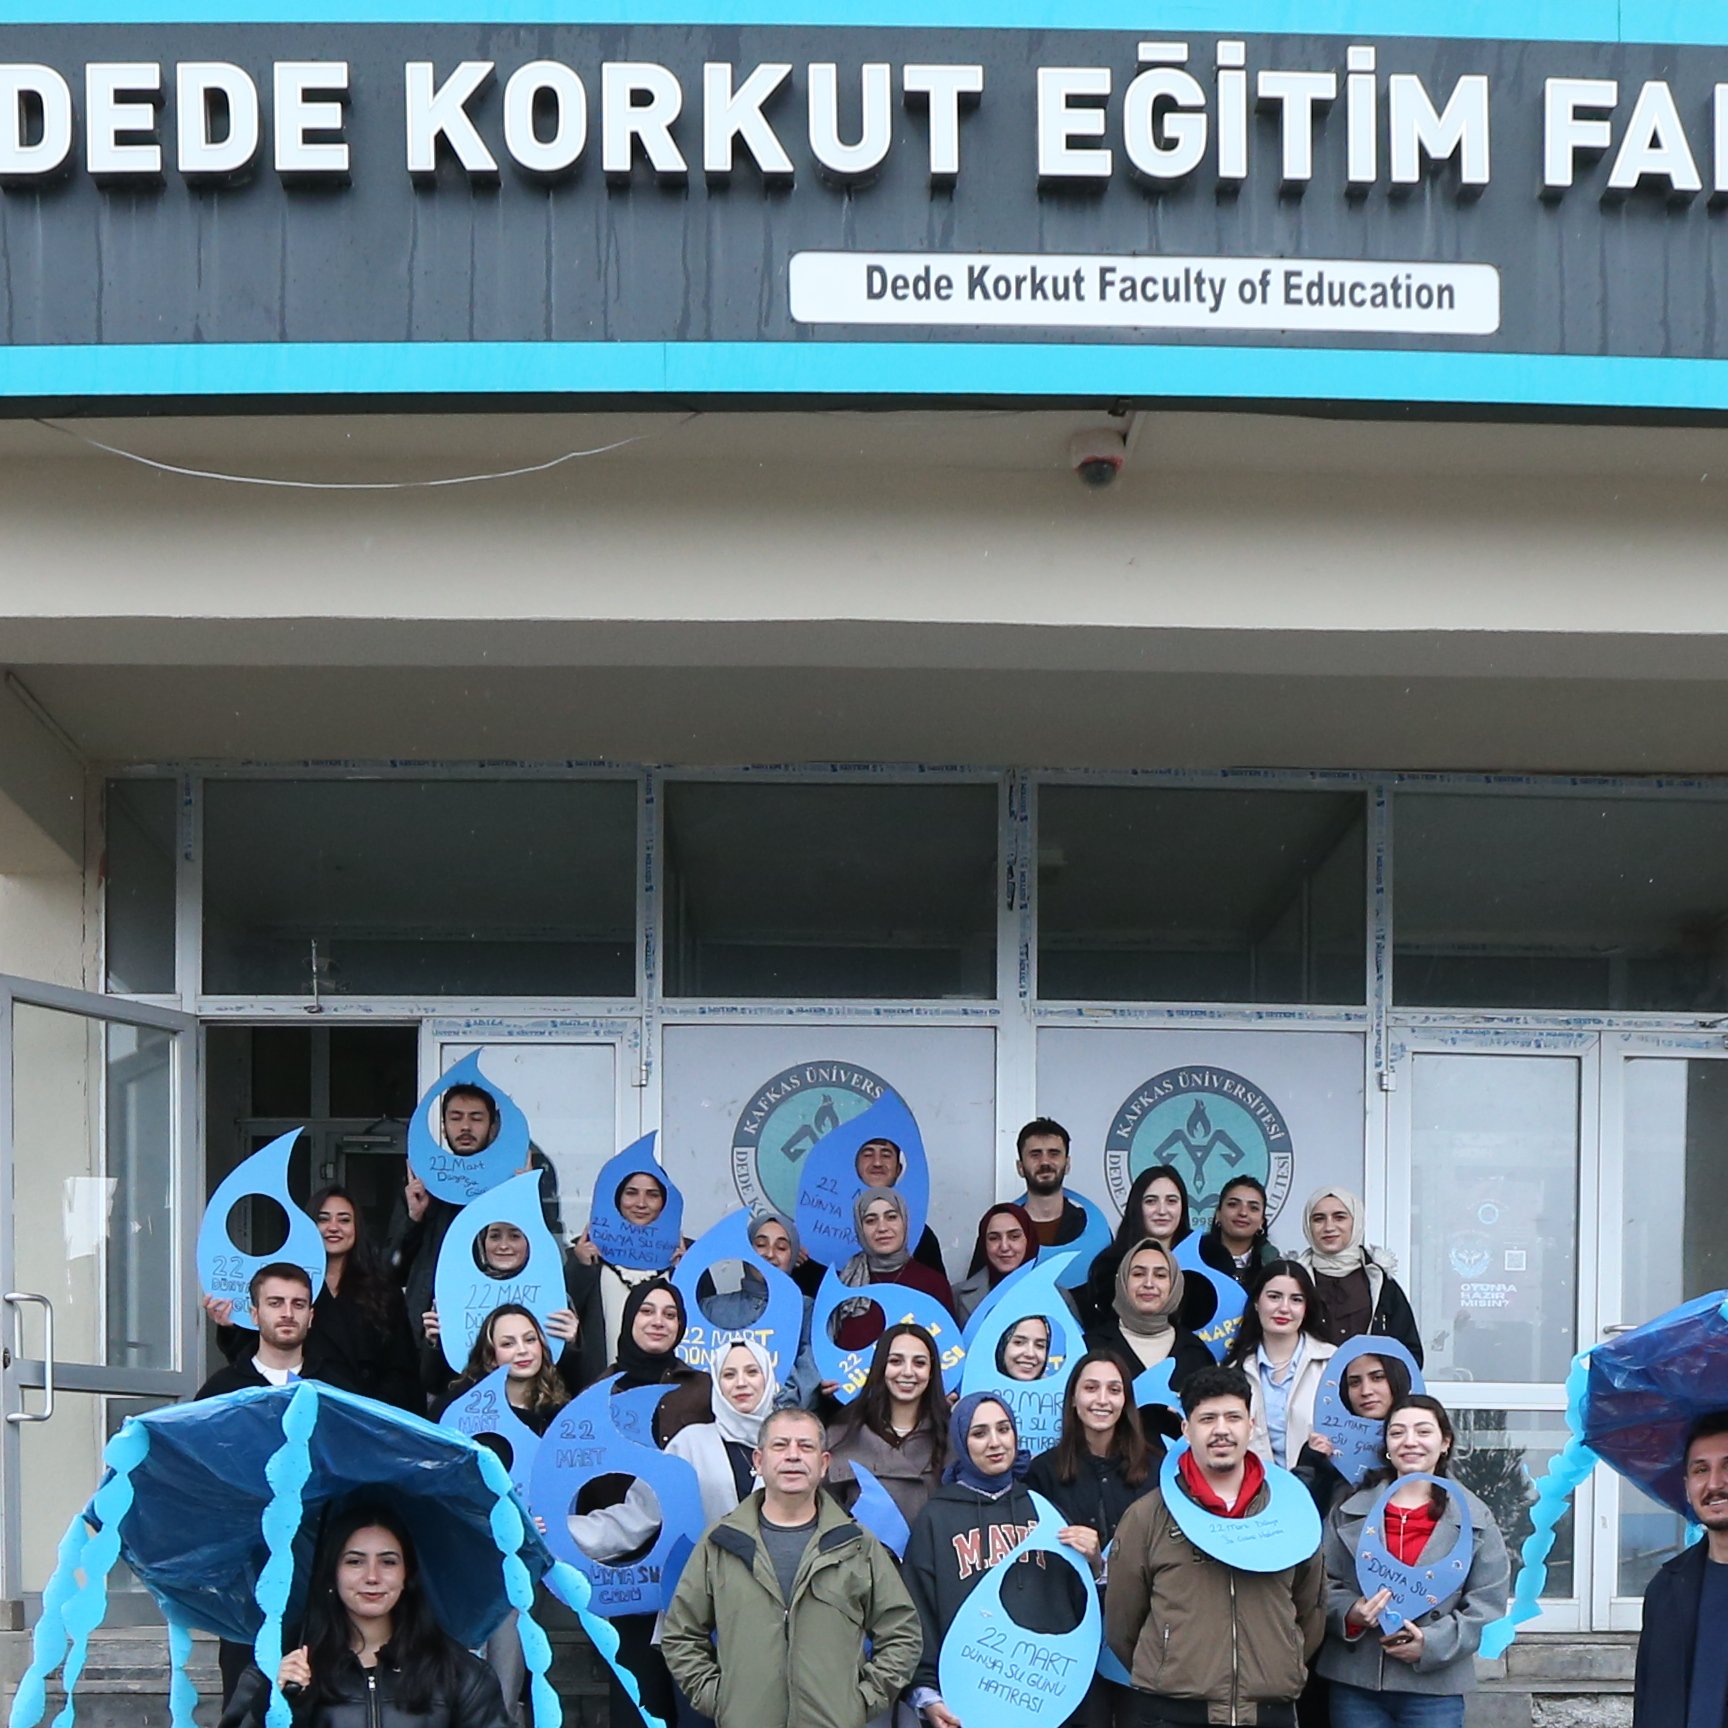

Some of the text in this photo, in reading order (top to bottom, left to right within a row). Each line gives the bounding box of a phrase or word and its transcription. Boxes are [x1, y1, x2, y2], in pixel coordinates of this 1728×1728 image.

[405, 60, 984, 174] KORKUT
[1037, 40, 1491, 184] EĞİTİM
[866, 265, 1455, 313] Dede Korkut Faculty of Education
[743, 1065, 884, 1136] KAFKAS ÜNİVERS
[1116, 1070, 1286, 1141] KAFKAS ÜNİVERSİTESİ
[452, 1158, 486, 1172] Mart
[735, 1150, 755, 1196] DEDE
[1109, 1153, 1126, 1199] DEDE
[815, 1176, 838, 1196] 22
[800, 1190, 843, 1217] DÜNYA
[591, 1217, 659, 1237] 22 MART
[1190, 1216, 1213, 1227] 998
[211, 1255, 245, 1279] 22
[601, 1245, 659, 1263] HATIRASI
[464, 1283, 542, 1310] 22 MART
[838, 1352, 863, 1374] 22
[464, 1389, 499, 1415] 22
[1018, 1390, 1065, 1416] MAR
[559, 1419, 596, 1441] 22
[1321, 1415, 1342, 1428] 22
[1410, 1581, 1428, 1597] SU
[977, 1626, 1078, 1679] 22 MART
[961, 1644, 1067, 1698] DÜNYA SU GÜNÜ
[978, 1675, 1044, 1714] HATIRASI
